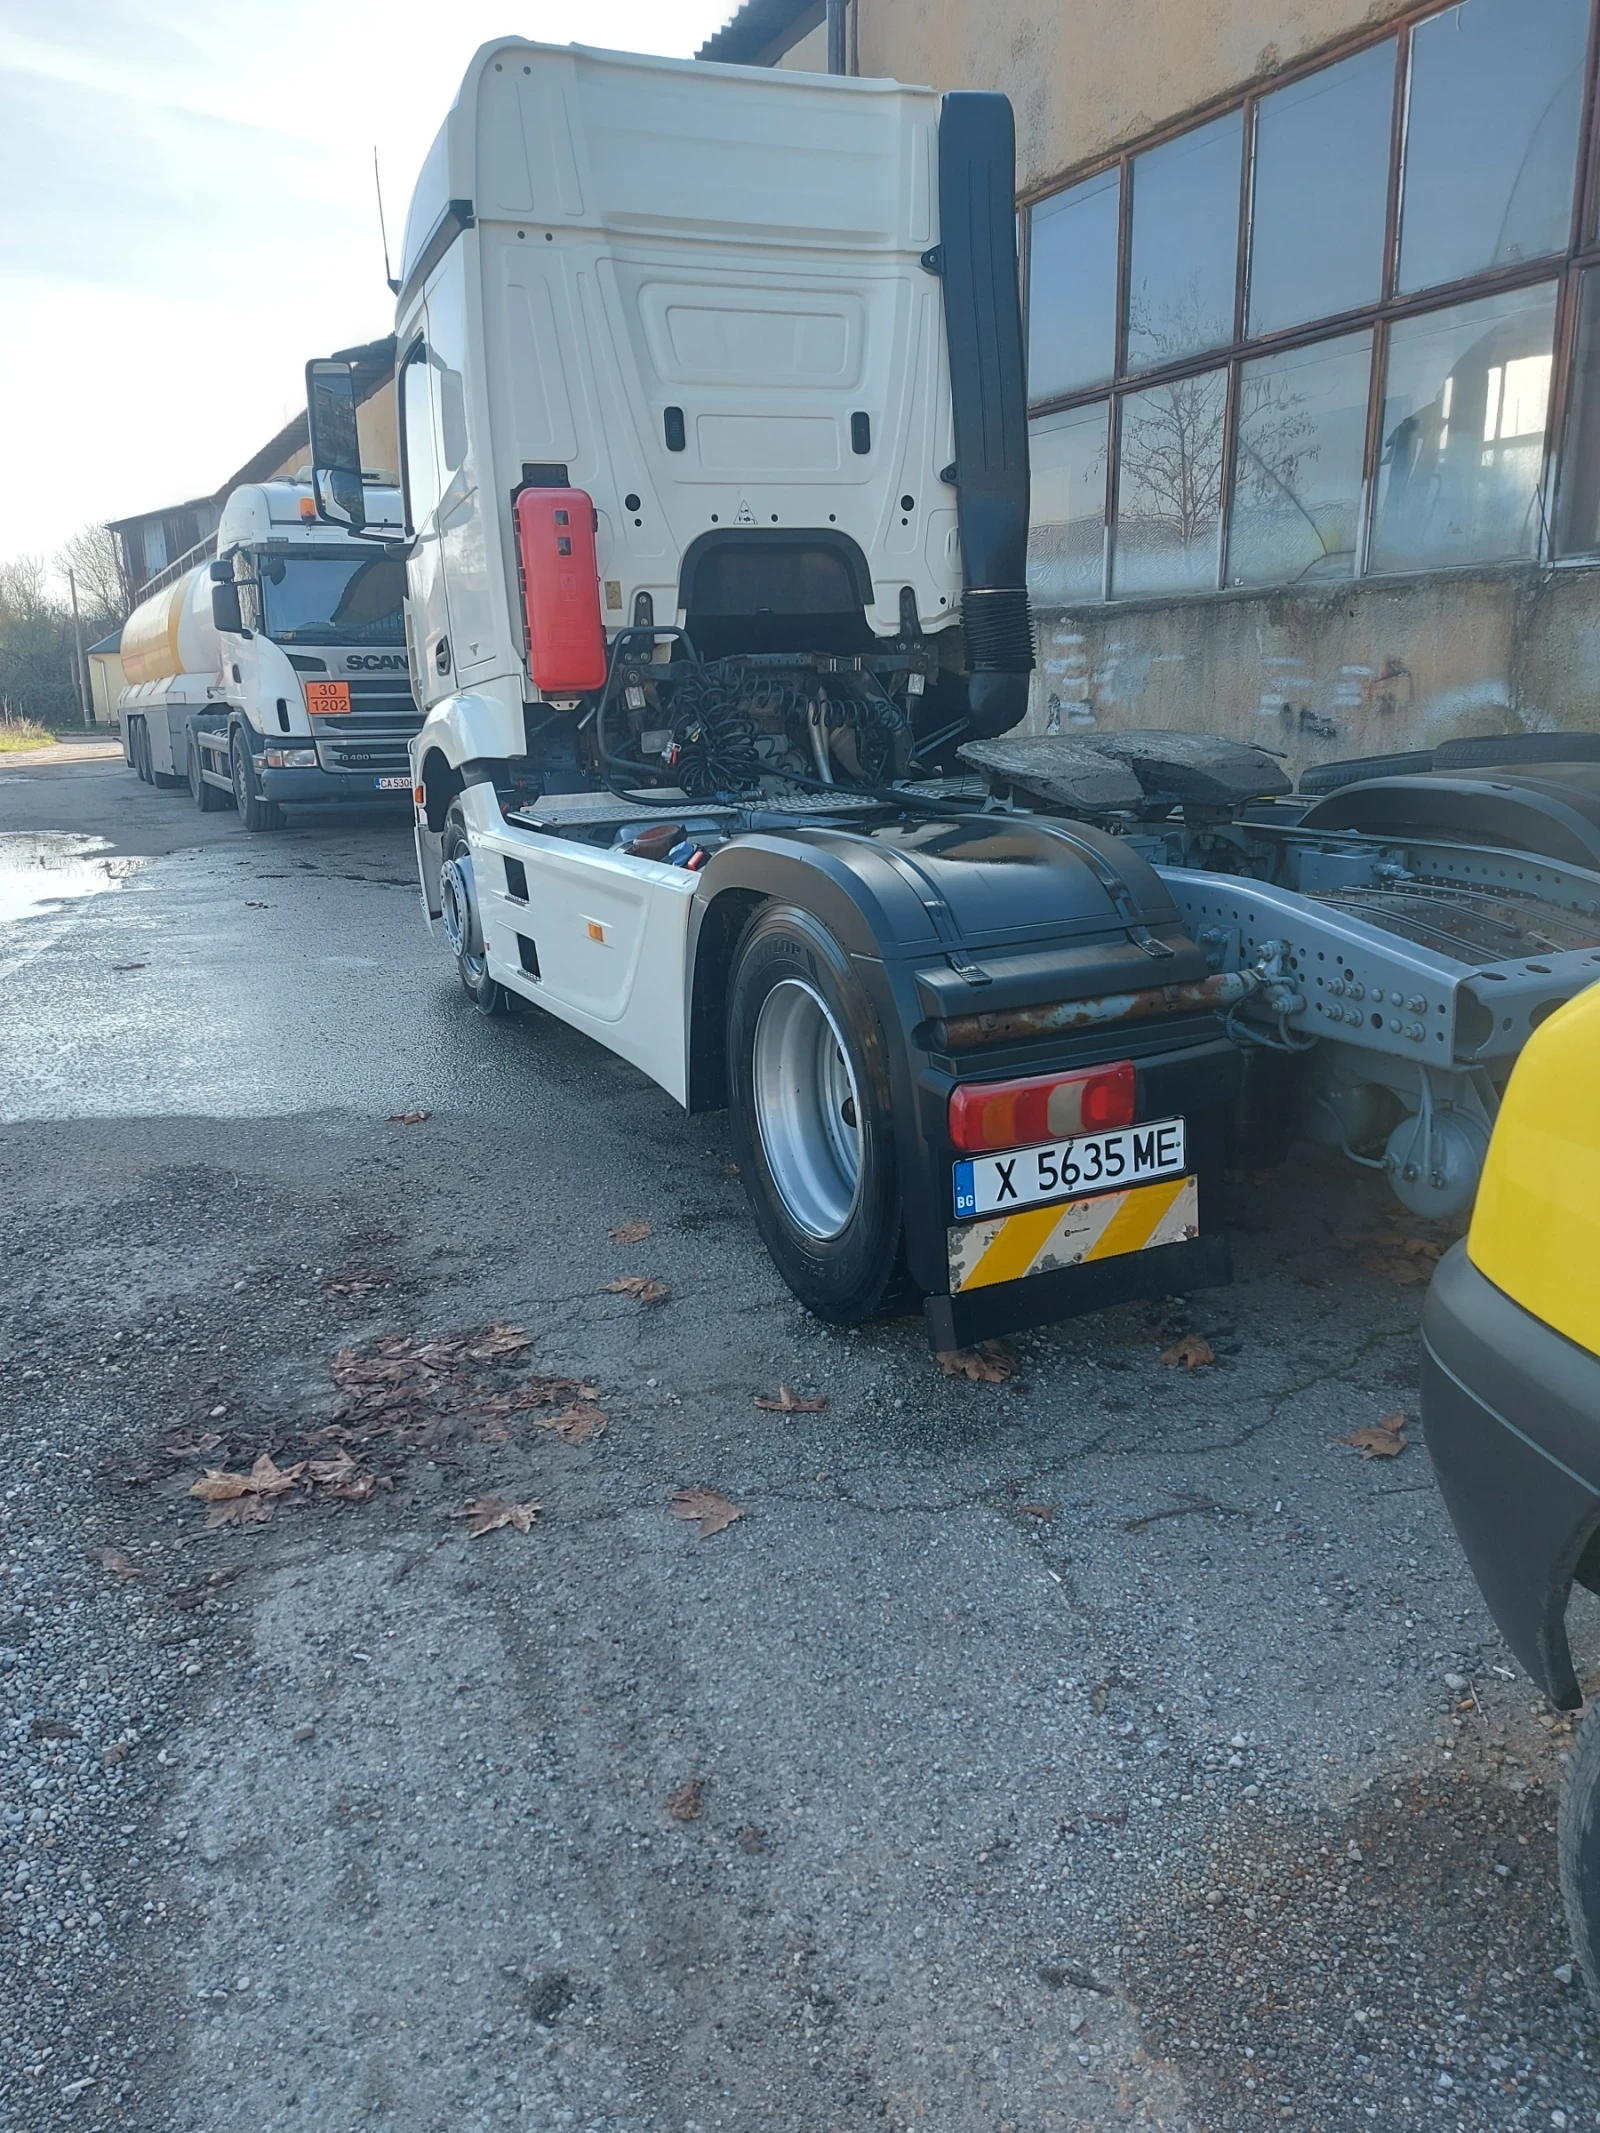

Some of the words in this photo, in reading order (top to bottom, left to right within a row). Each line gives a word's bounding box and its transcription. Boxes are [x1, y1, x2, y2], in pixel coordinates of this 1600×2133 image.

[346, 655, 409, 670] SCAN
[319, 684, 337, 695] 30
[312, 700, 348, 711] 1202
[994, 1159, 1018, 1202] X
[1037, 1137, 1126, 1191] 5635
[1133, 1127, 1178, 1172] ME
[957, 1194, 974, 1209] BG
